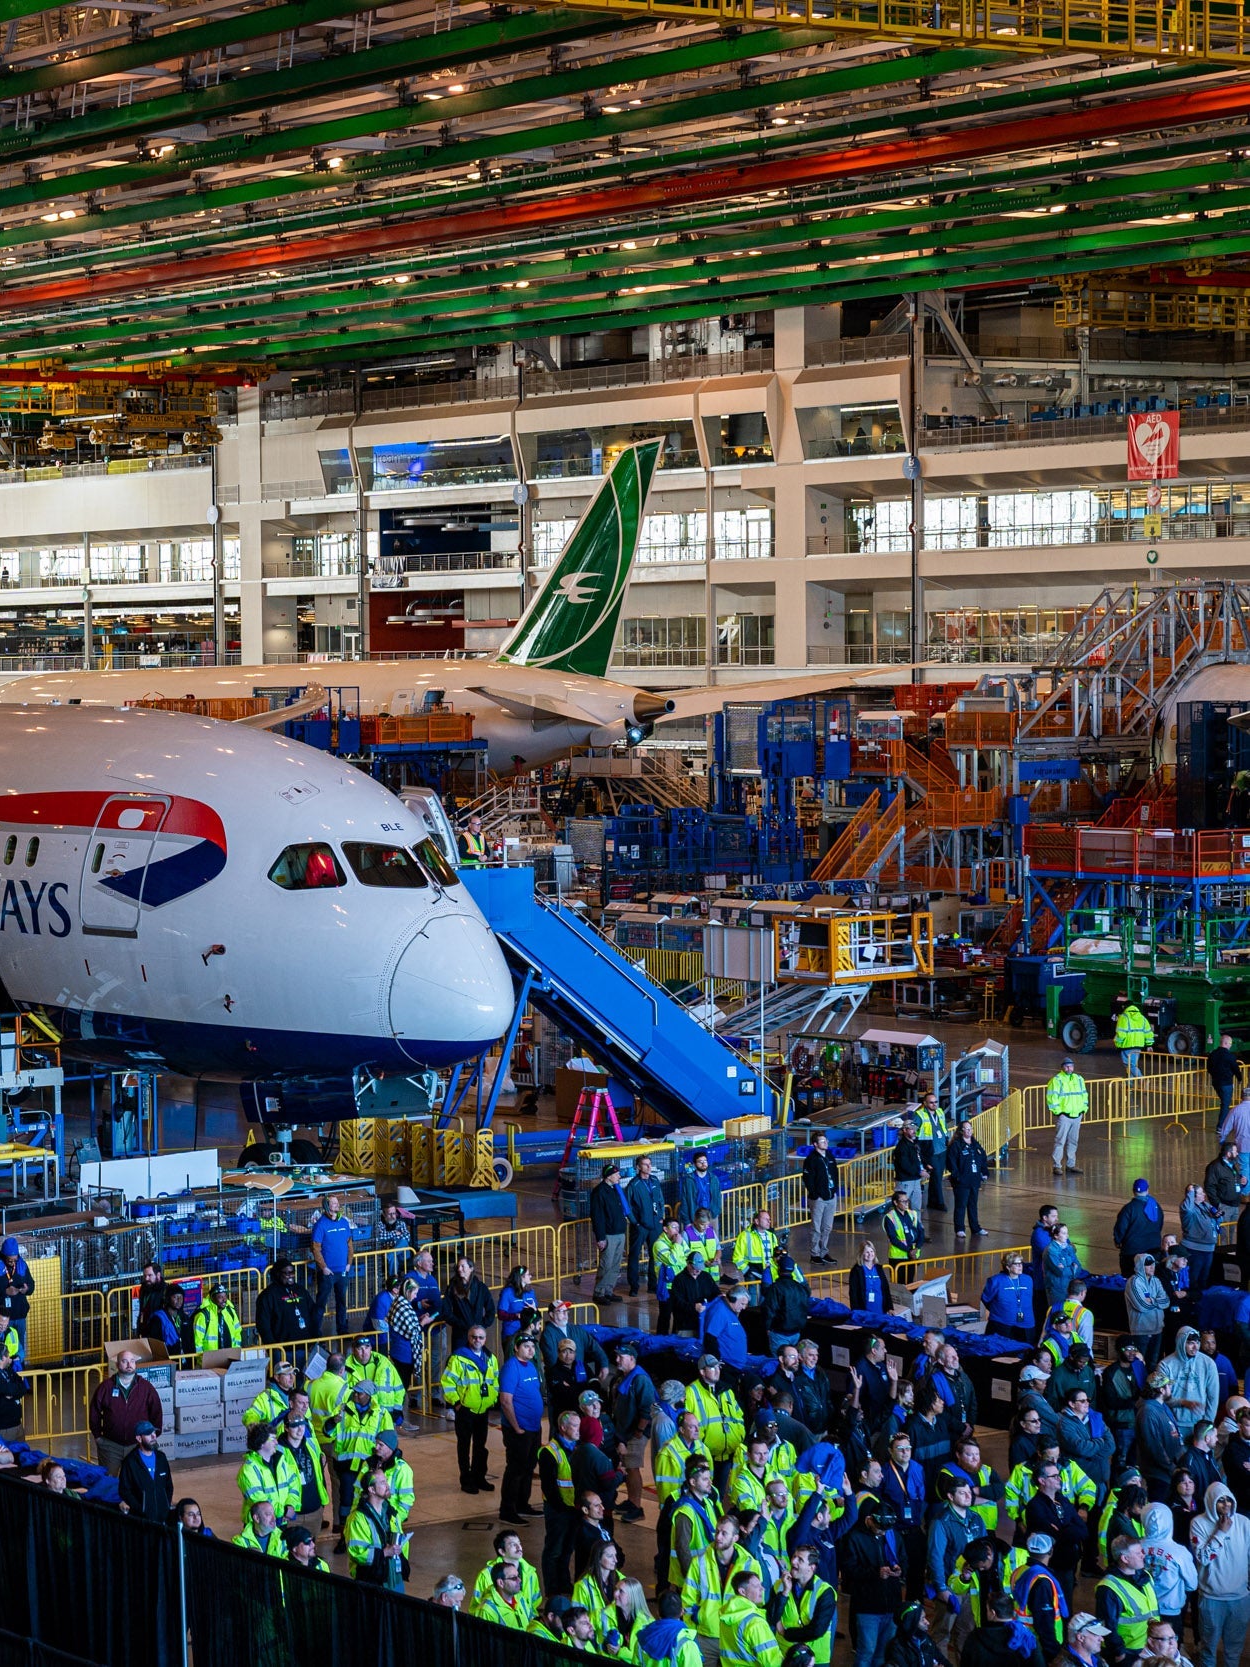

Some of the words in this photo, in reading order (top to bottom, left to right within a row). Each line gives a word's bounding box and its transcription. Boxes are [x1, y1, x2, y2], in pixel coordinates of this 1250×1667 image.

[1145, 414, 1162, 424] AED
[908, 468, 914, 477] 7
[380, 822, 405, 832] BLE
